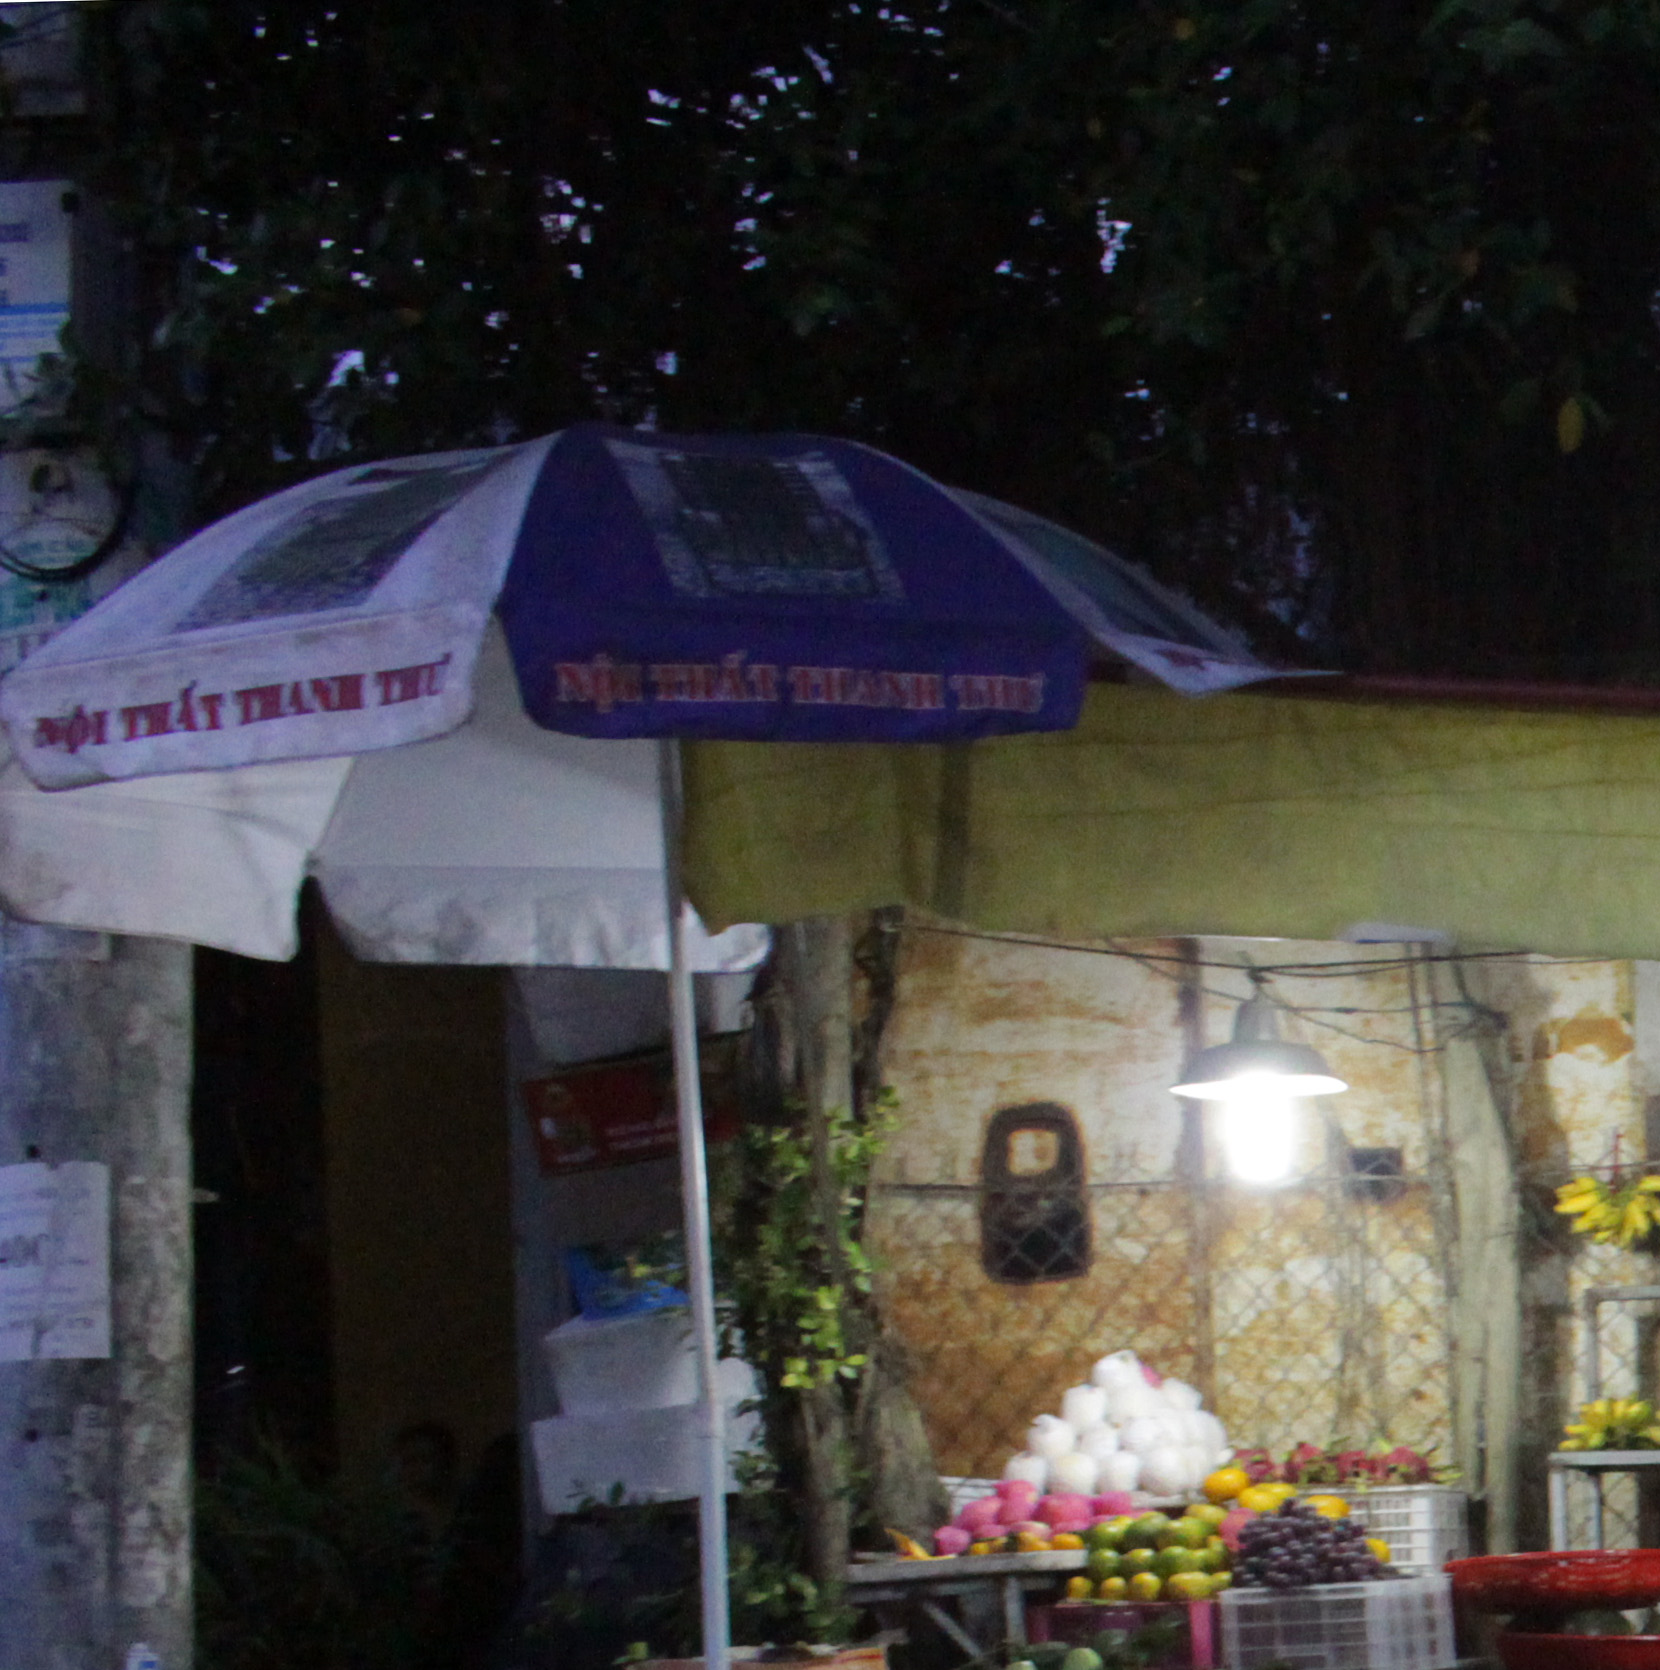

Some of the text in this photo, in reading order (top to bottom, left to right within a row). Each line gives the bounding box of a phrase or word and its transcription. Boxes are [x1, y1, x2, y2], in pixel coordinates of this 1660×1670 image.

[34, 652, 453, 754] NỘI THẤT THANH THƯ
[786, 665, 945, 710] THANH
